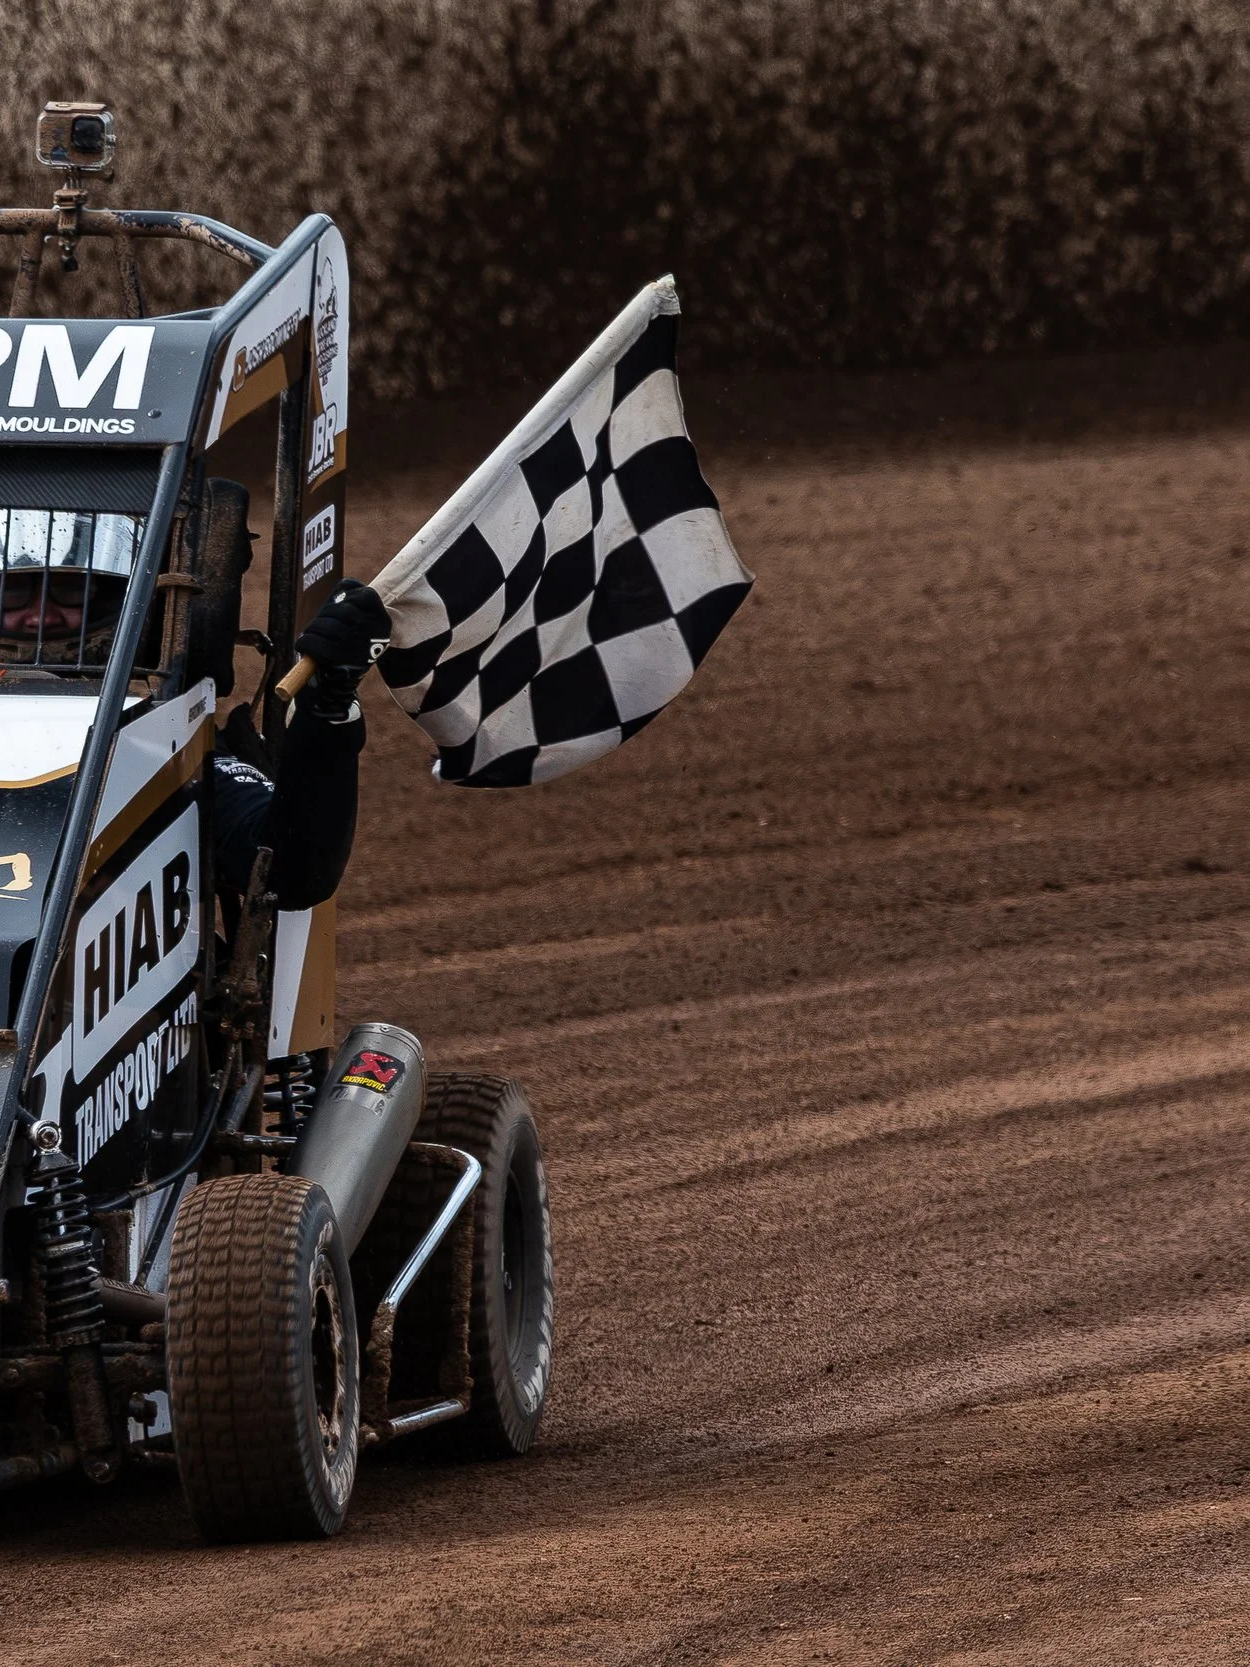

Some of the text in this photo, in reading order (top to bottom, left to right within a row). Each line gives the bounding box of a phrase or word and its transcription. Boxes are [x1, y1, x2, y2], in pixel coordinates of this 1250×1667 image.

[308, 403, 337, 473] JBR
[306, 516, 331, 557] HIAB
[82, 850, 191, 1039] HIAB
[75, 1020, 169, 1173] TRANSPORT
